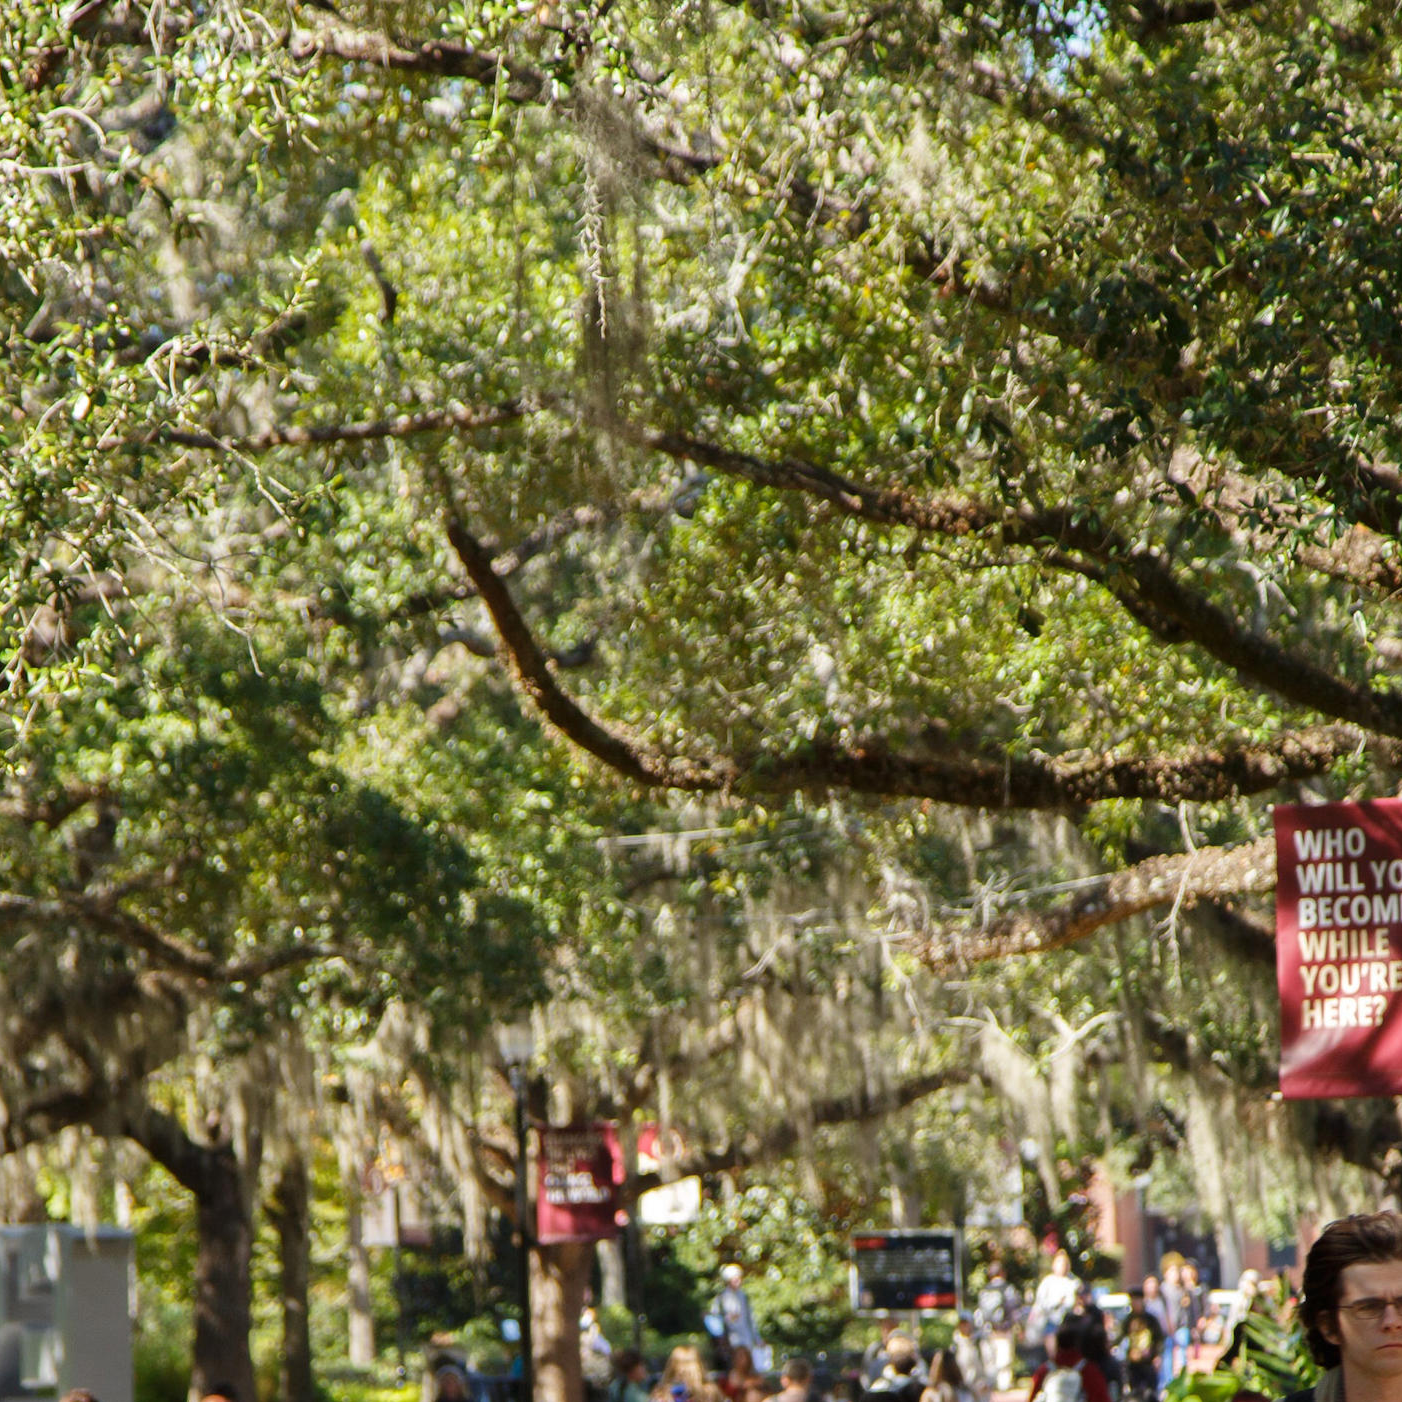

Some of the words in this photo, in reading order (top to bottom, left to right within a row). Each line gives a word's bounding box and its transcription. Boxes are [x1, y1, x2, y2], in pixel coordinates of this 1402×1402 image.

[1294, 828, 1365, 860] WHO
[1296, 862, 1364, 892] WILL
[1298, 928, 1391, 962] WHILE
[1302, 995, 1388, 1030] HERE?
